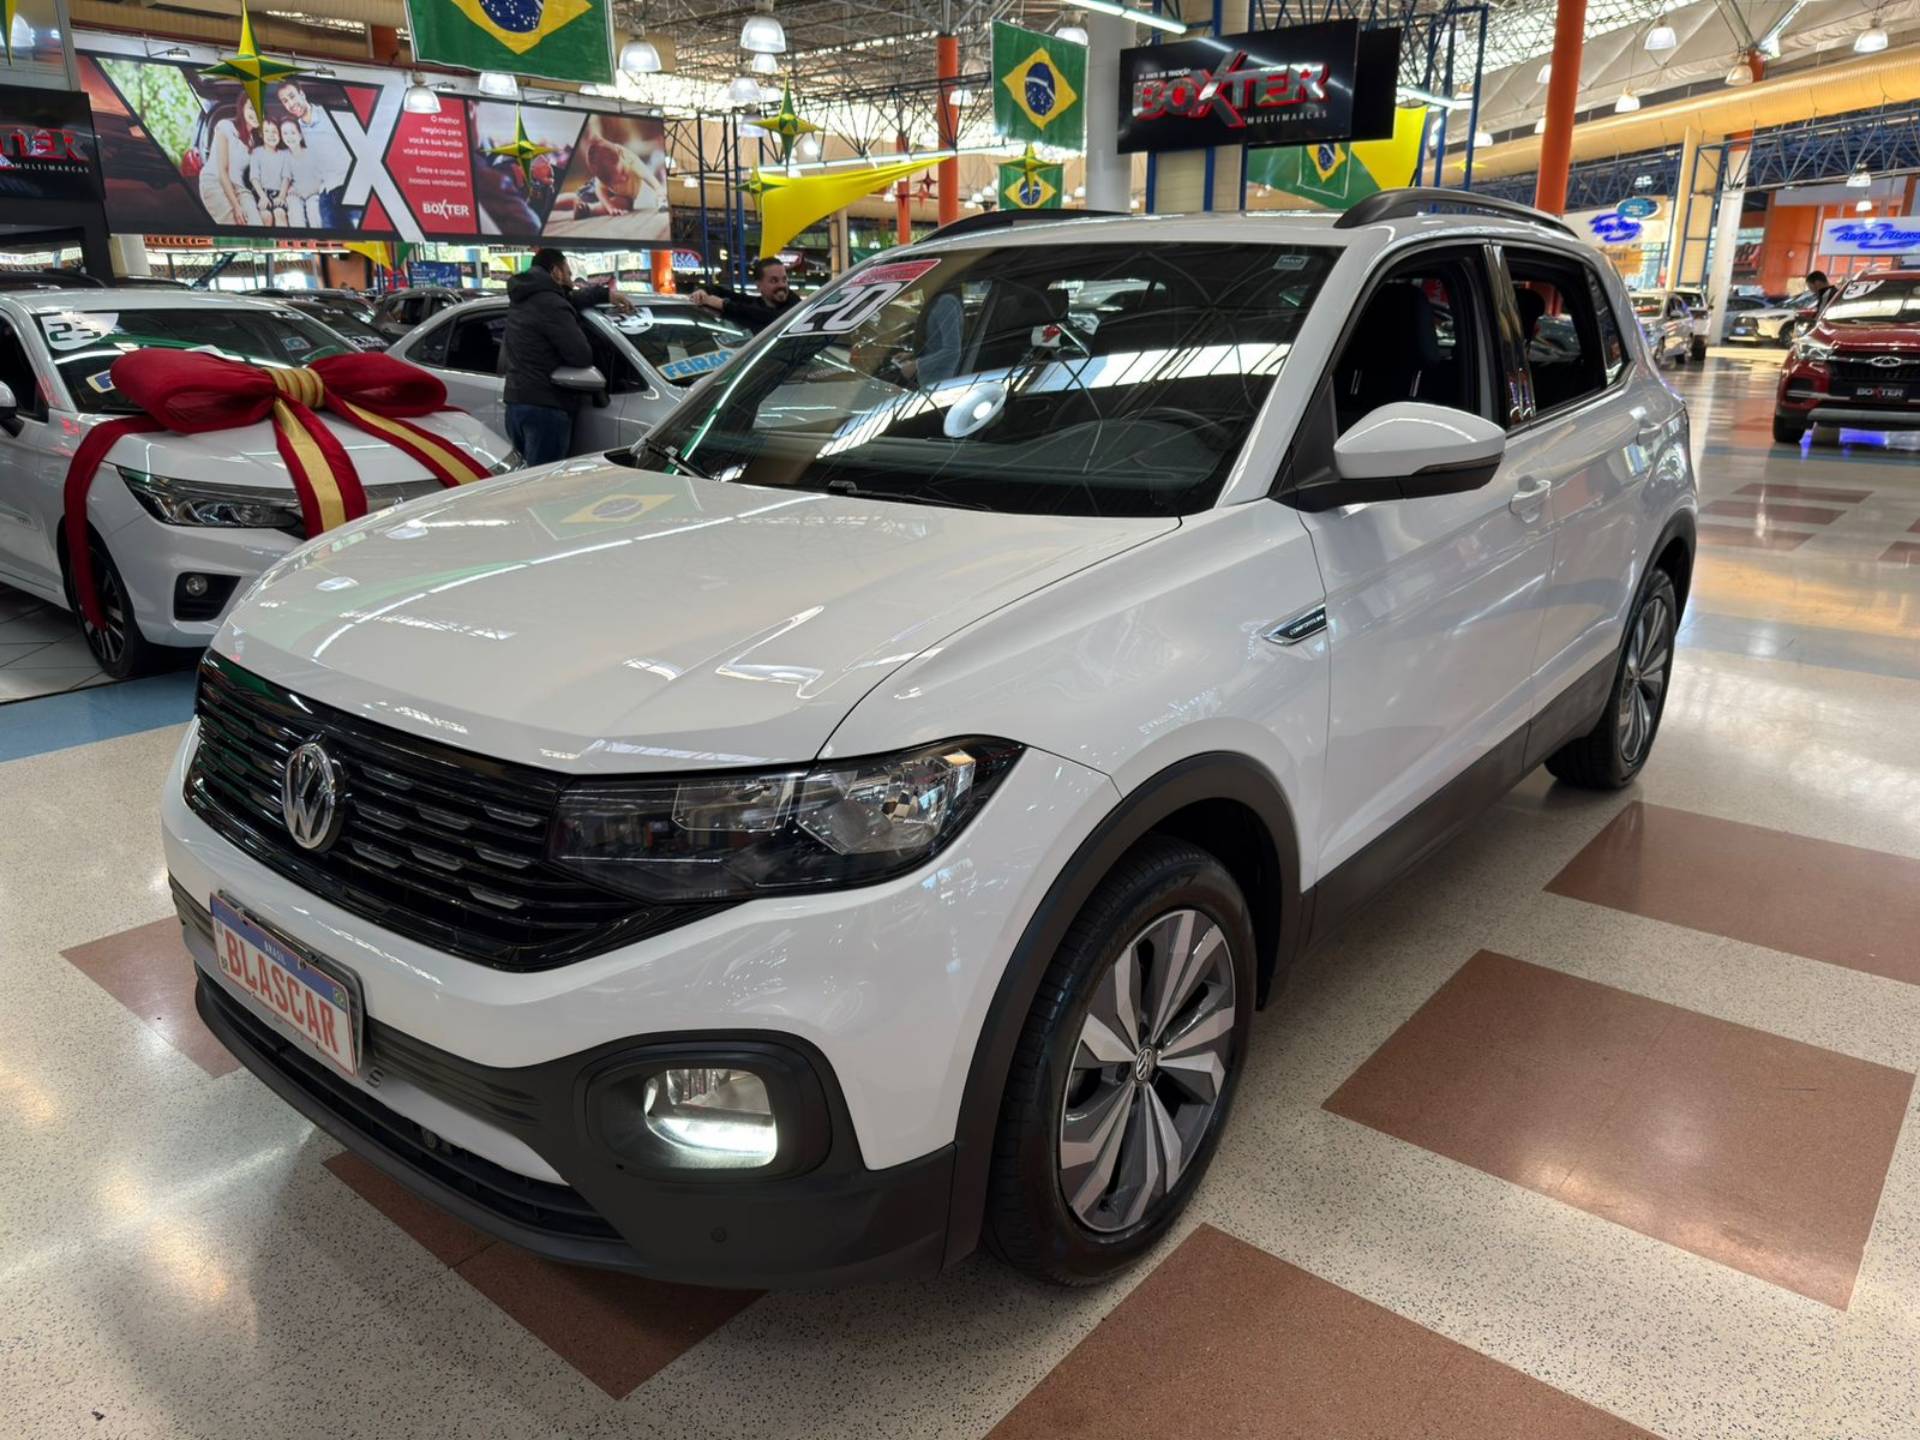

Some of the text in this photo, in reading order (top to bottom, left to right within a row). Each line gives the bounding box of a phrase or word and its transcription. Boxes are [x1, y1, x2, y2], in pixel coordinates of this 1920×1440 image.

[1132, 50, 1331, 128] BOXTER
[1246, 110, 1328, 124] MULTIMARCAS
[422, 199, 469, 219] BOXTER
[225, 929, 340, 1055] BLASCAR
